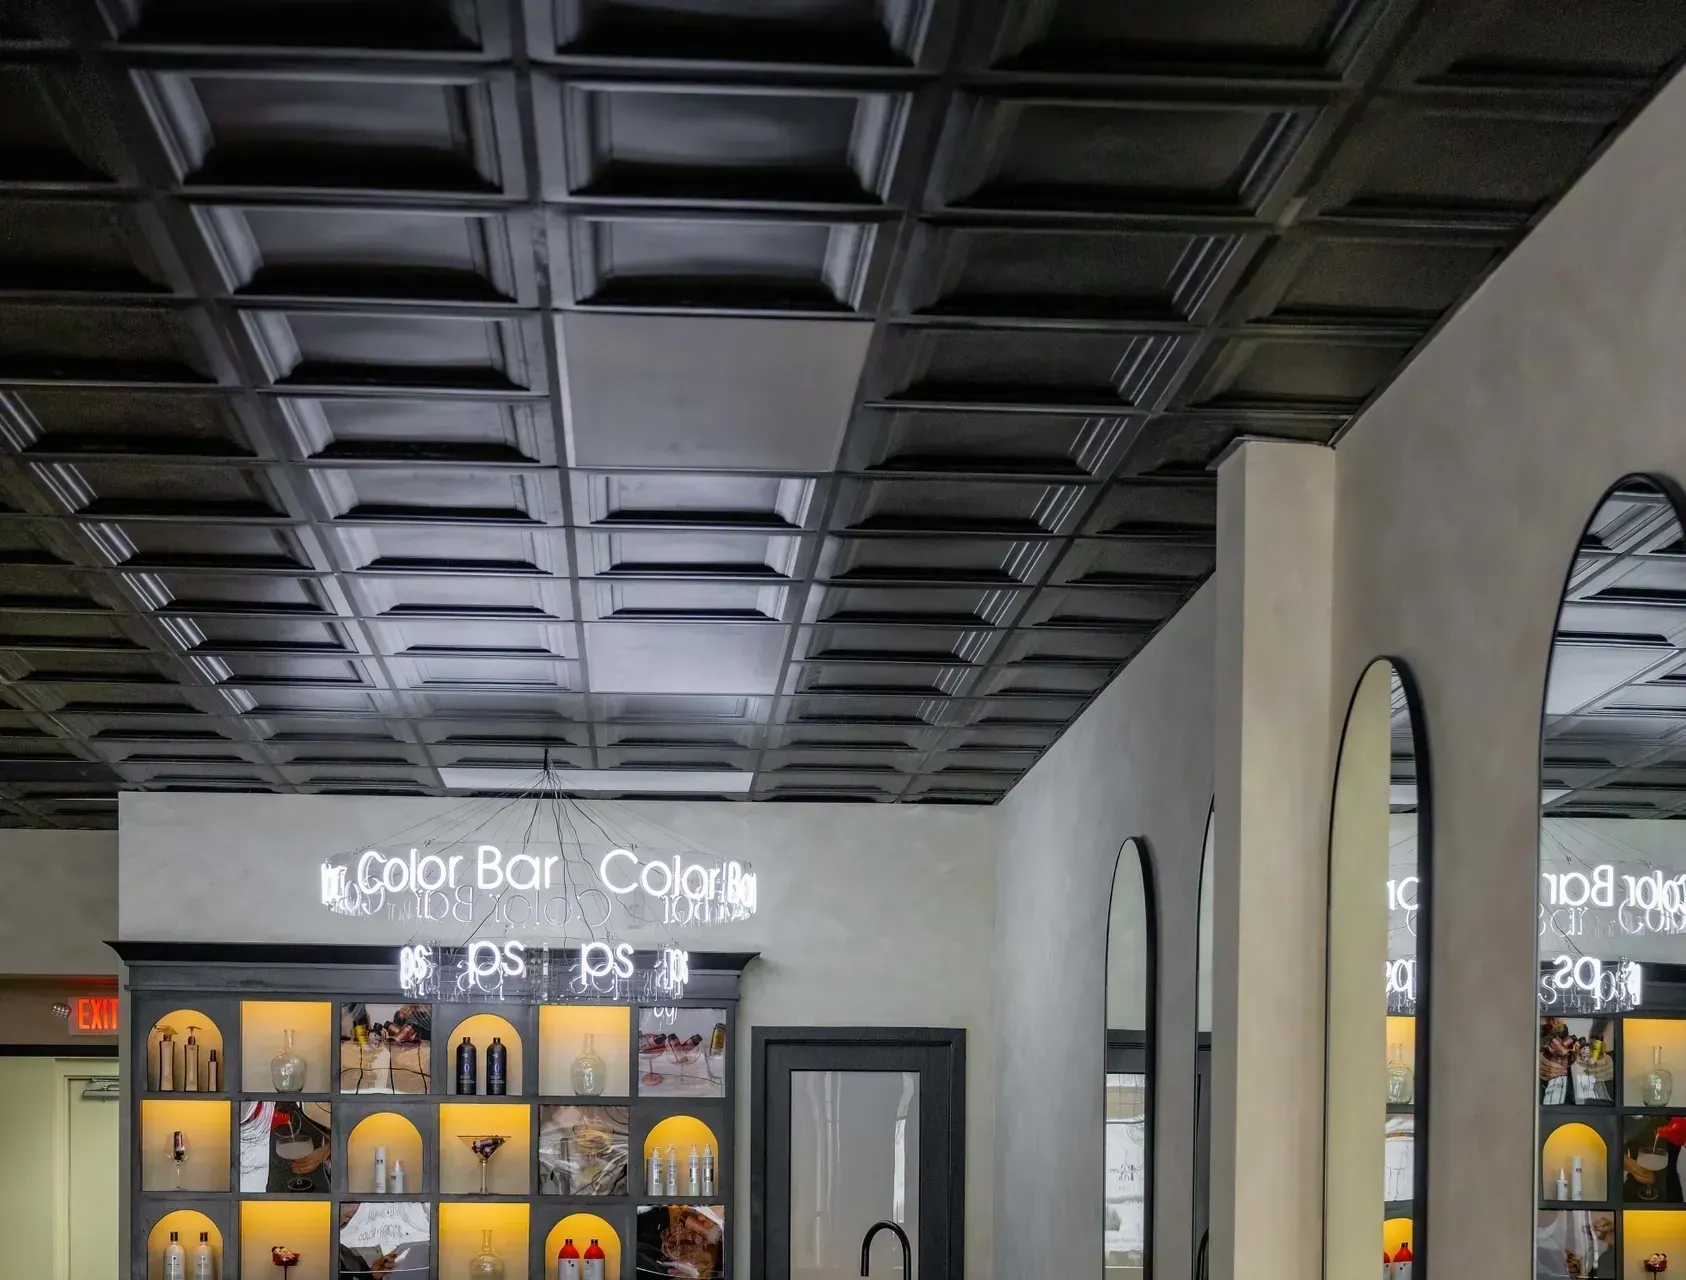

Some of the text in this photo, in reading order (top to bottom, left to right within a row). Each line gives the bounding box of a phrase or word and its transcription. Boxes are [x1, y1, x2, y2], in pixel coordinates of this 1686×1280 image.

[357, 847, 463, 894] Color
[477, 844, 560, 891] Bar
[600, 848, 720, 900] Color
[468, 940, 525, 985] ps
[581, 941, 634, 985] ps
[77, 998, 119, 1030] EXIT
